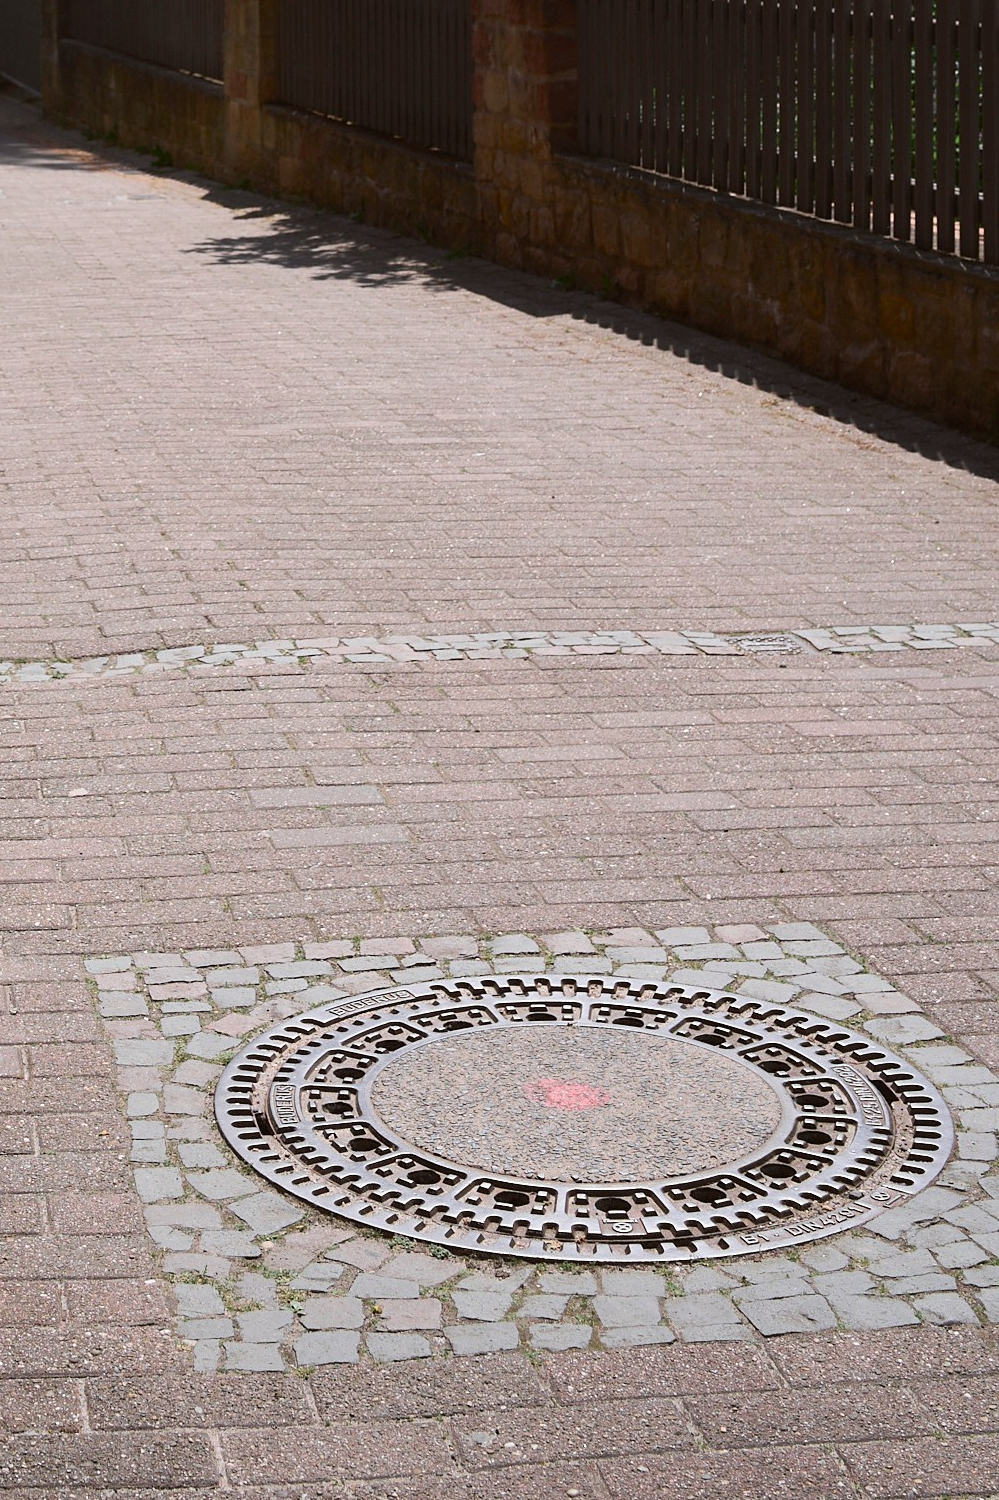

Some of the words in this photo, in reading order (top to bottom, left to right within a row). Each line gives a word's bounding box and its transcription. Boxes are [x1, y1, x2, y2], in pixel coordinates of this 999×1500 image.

[329, 990, 411, 1016] BUDERUS
[276, 1086, 299, 1124] BUDERUS
[740, 1232, 770, 1245] B1
